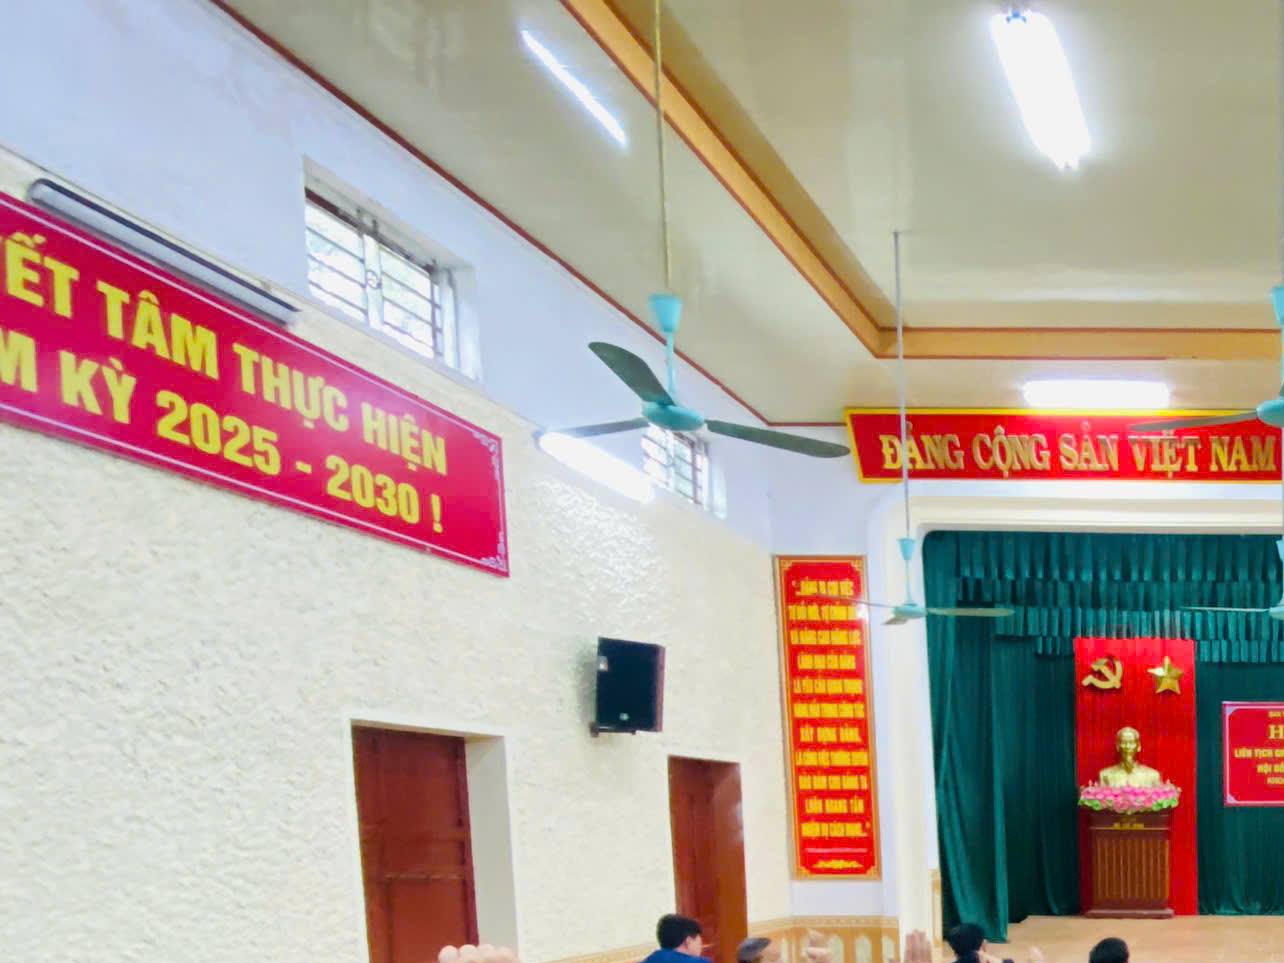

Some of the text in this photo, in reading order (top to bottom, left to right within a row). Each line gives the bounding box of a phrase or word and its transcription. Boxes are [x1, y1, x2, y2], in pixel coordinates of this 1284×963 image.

[0, 231, 448, 476] ẾT TÂM THỰC HIỆN
[59, 349, 137, 425] KỲ
[154, 389, 282, 476] 2025
[324, 454, 420, 525] 2030
[879, 421, 964, 470] ĐẢNG
[972, 424, 1050, 478] CỘNG
[1059, 421, 1119, 471] SẢN
[1128, 428, 1201, 478] VIỆT
[1209, 435, 1276, 472] NAM
